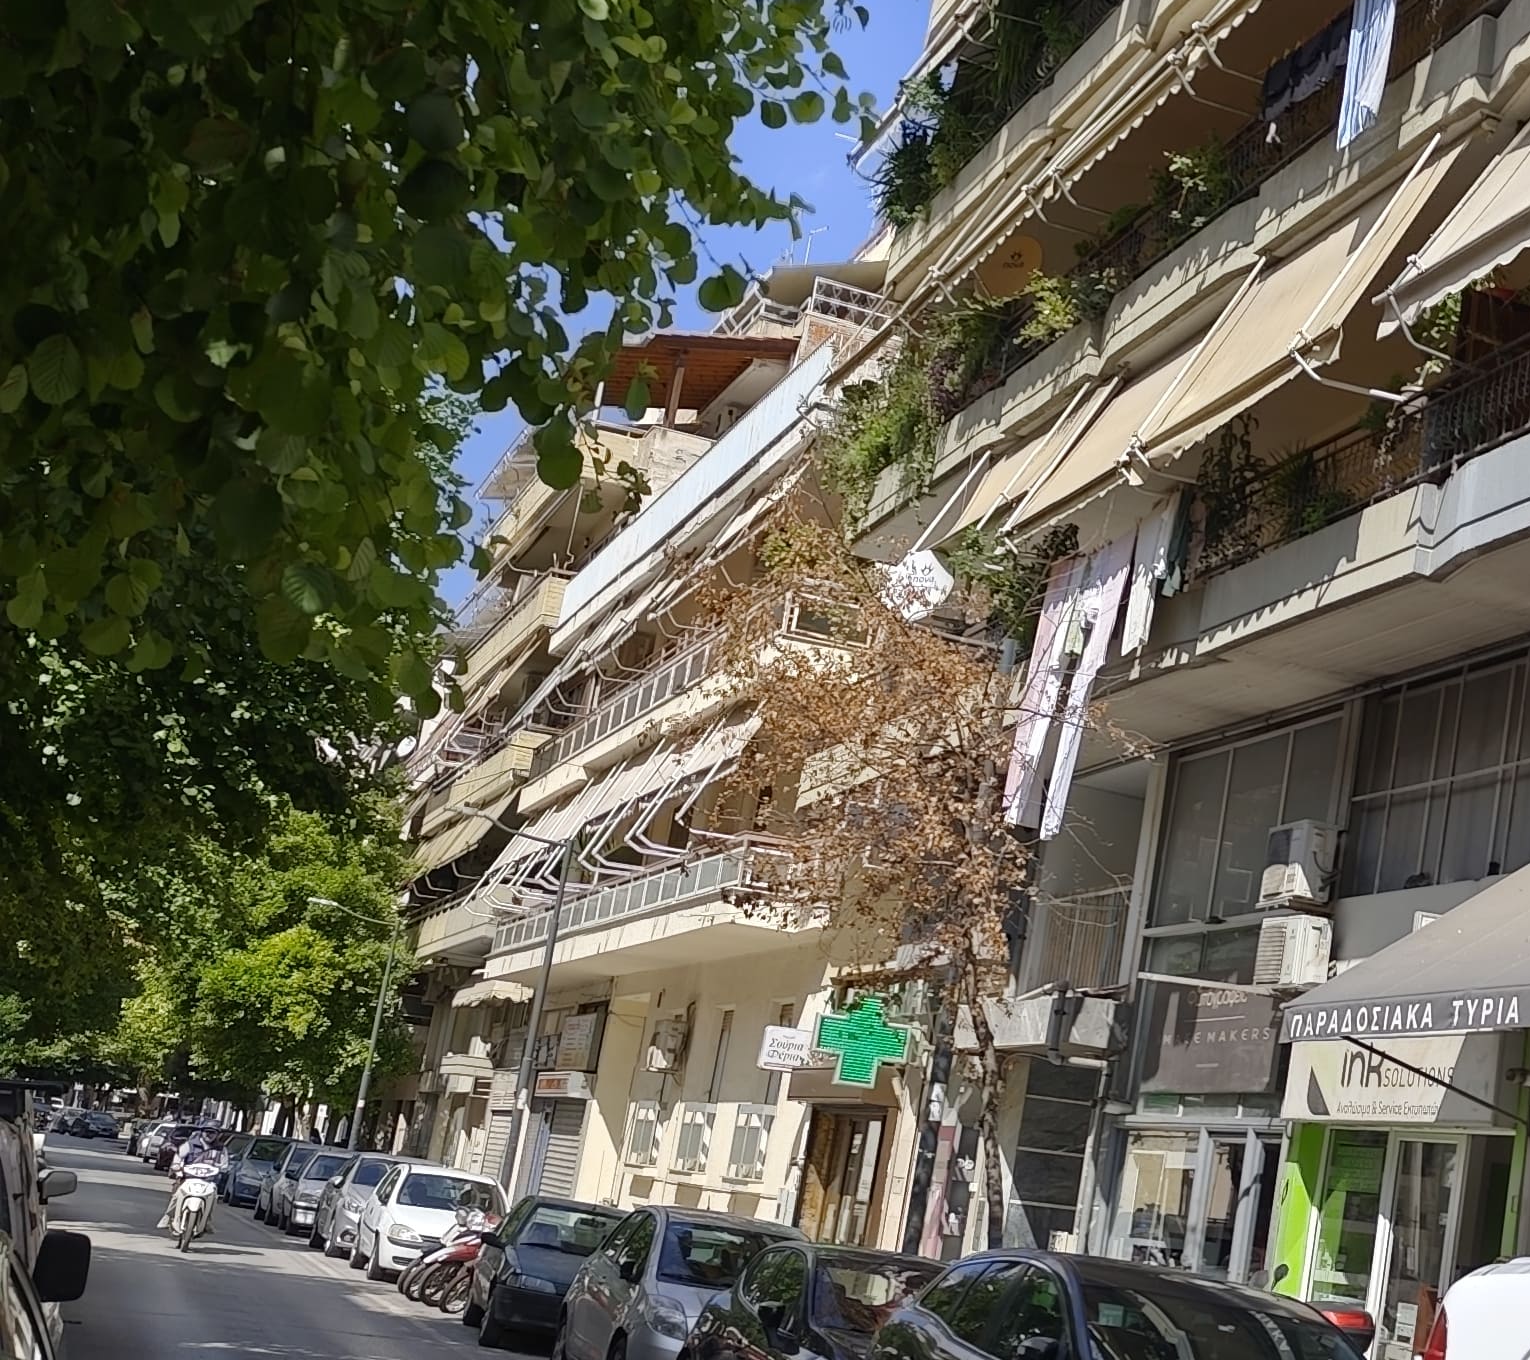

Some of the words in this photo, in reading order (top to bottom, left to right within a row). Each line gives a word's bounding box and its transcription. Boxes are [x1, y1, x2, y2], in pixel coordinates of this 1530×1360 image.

[1290, 1002, 1433, 1038] ΠΑΡΑΔΟΣΙΑΚΑ
[1452, 996, 1520, 1027] ΤΥΡΙΑ
[1207, 1027, 1271, 1044] MAKERS
[1378, 1102, 1402, 1115] Service
